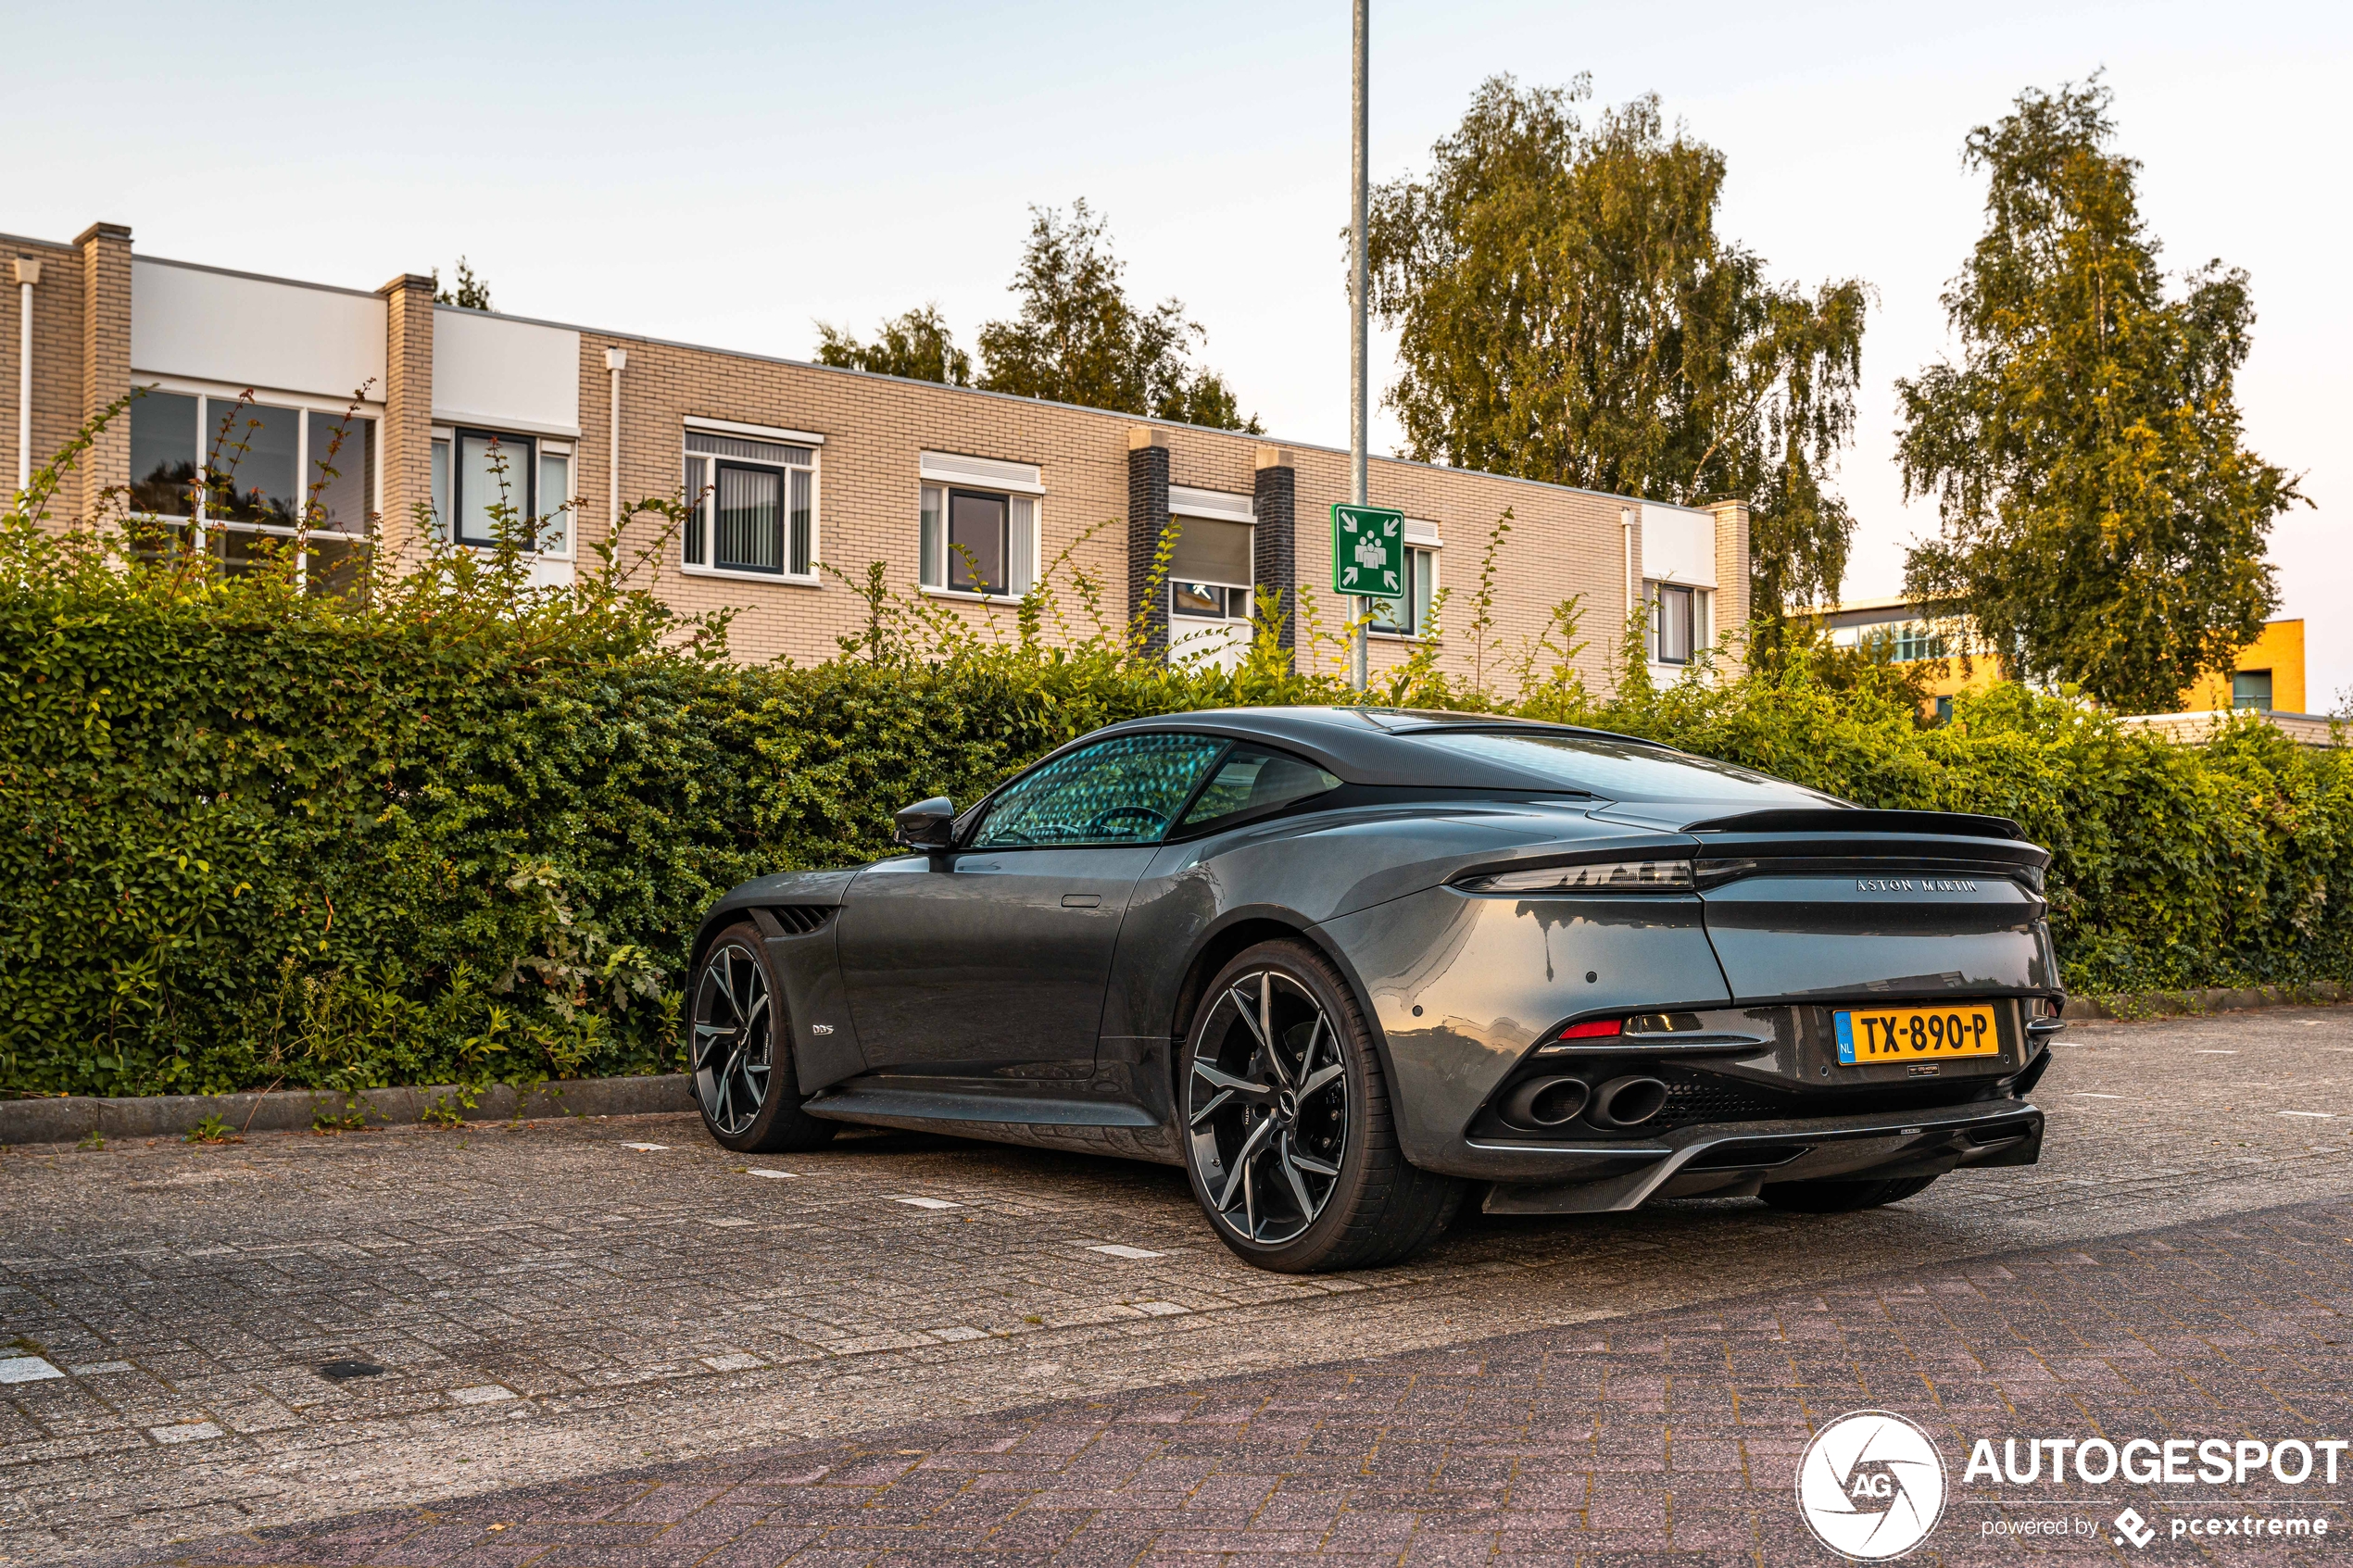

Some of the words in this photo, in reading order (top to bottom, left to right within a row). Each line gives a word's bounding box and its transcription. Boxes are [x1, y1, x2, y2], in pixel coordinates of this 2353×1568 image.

[1856, 880, 1913, 892] ASTON
[1920, 880, 1977, 893] MARTIN
[812, 1024, 835, 1035] DBS
[1860, 1013, 1987, 1054] TX-890-P
[1840, 1043, 1853, 1054] NL
